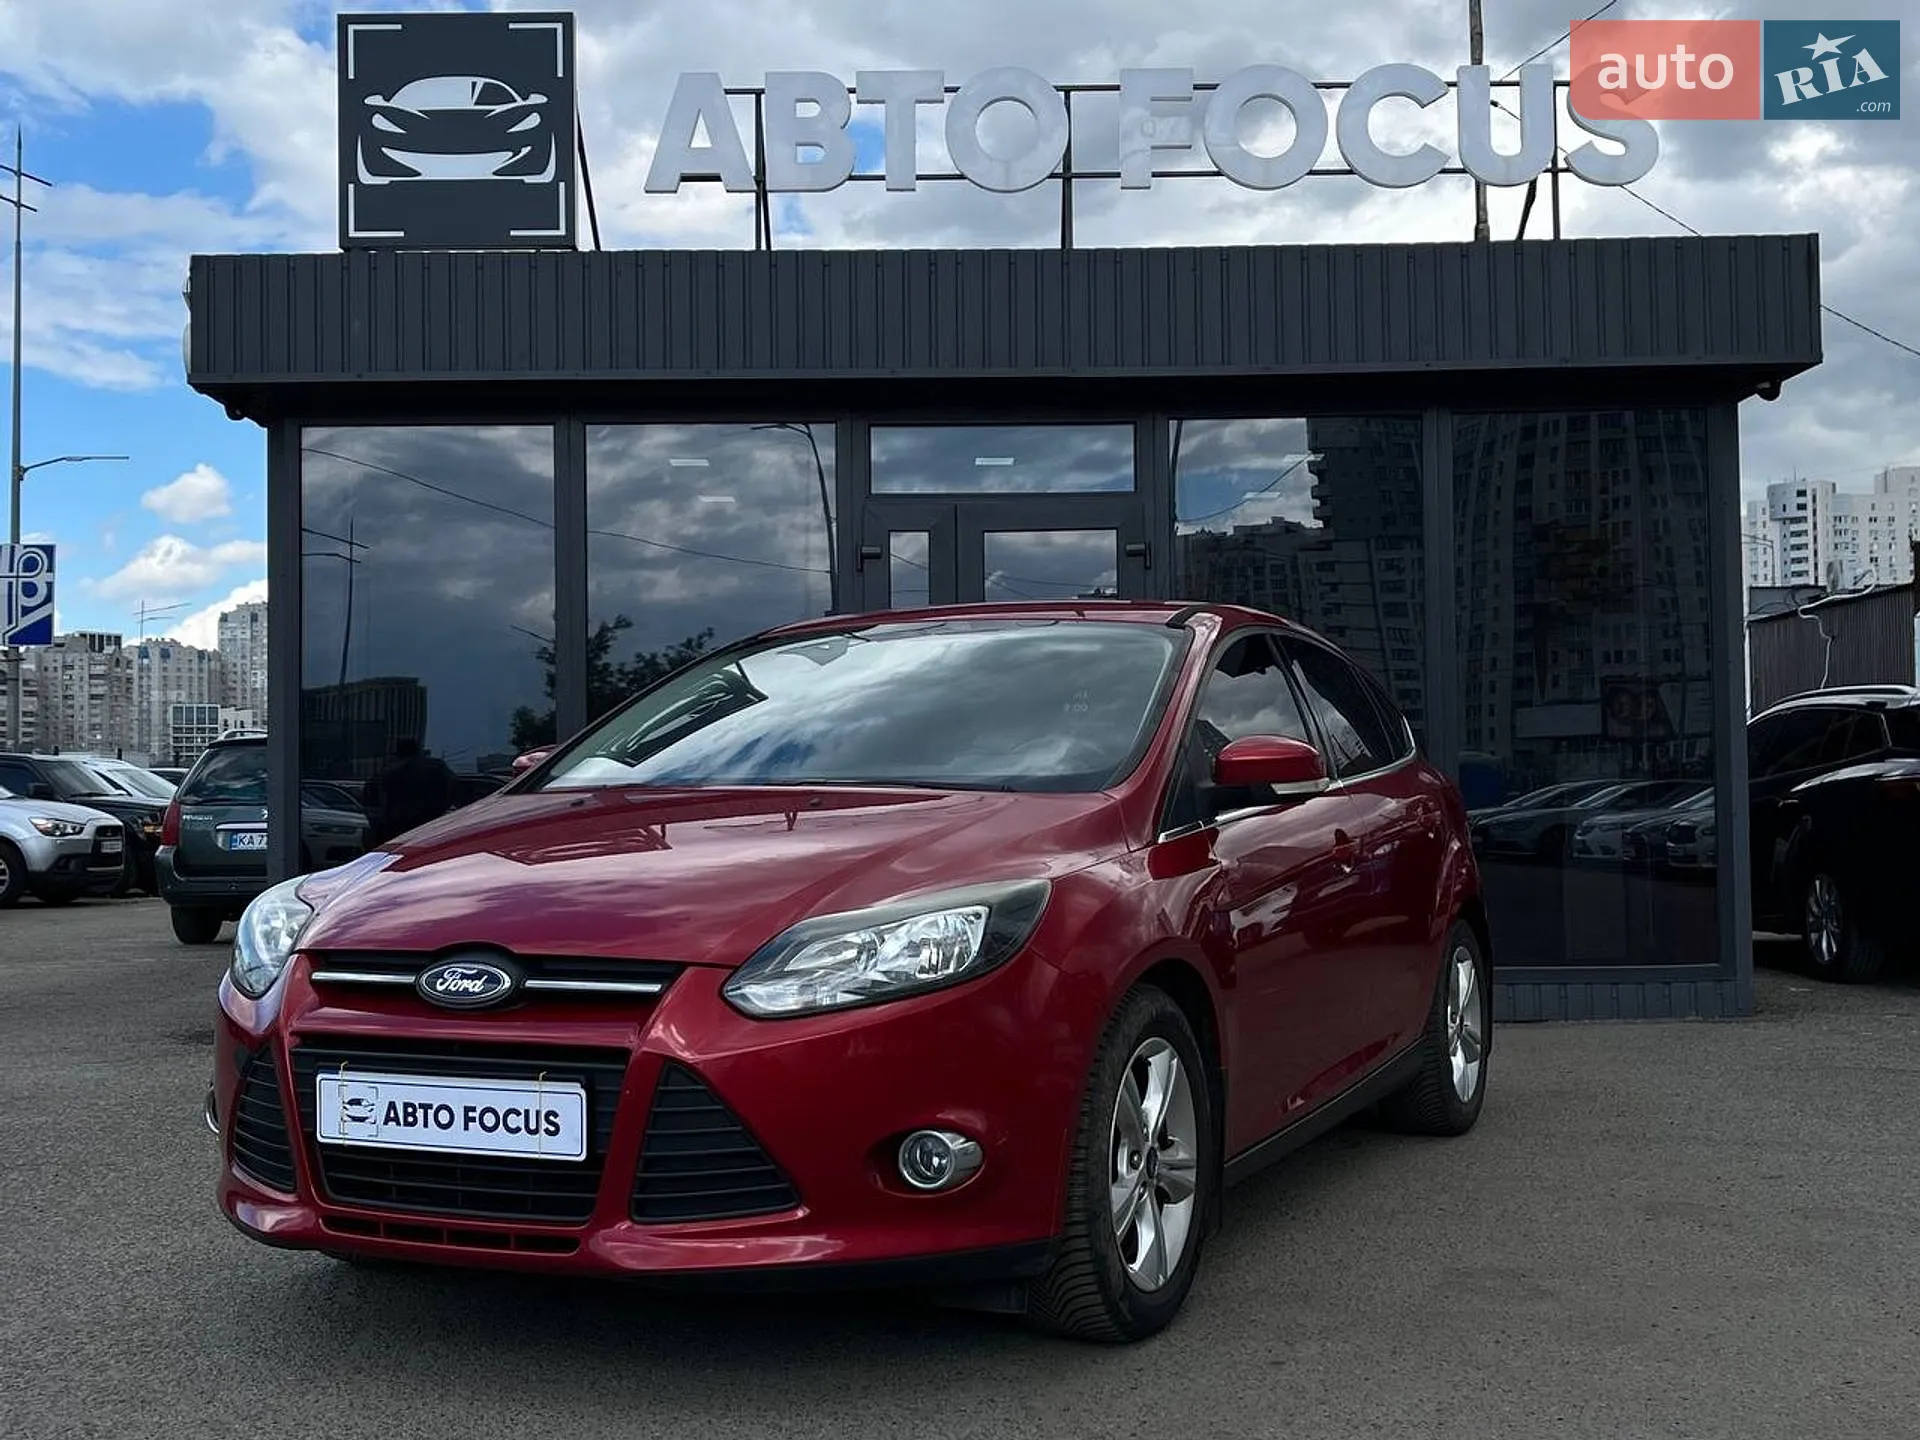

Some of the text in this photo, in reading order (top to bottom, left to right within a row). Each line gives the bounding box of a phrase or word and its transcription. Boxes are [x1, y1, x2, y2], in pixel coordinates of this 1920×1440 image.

[644, 61, 1659, 193] АВТО FOCUS
[436, 967, 487, 992] Ford
[383, 1101, 561, 1136] АВТО FOCUS
